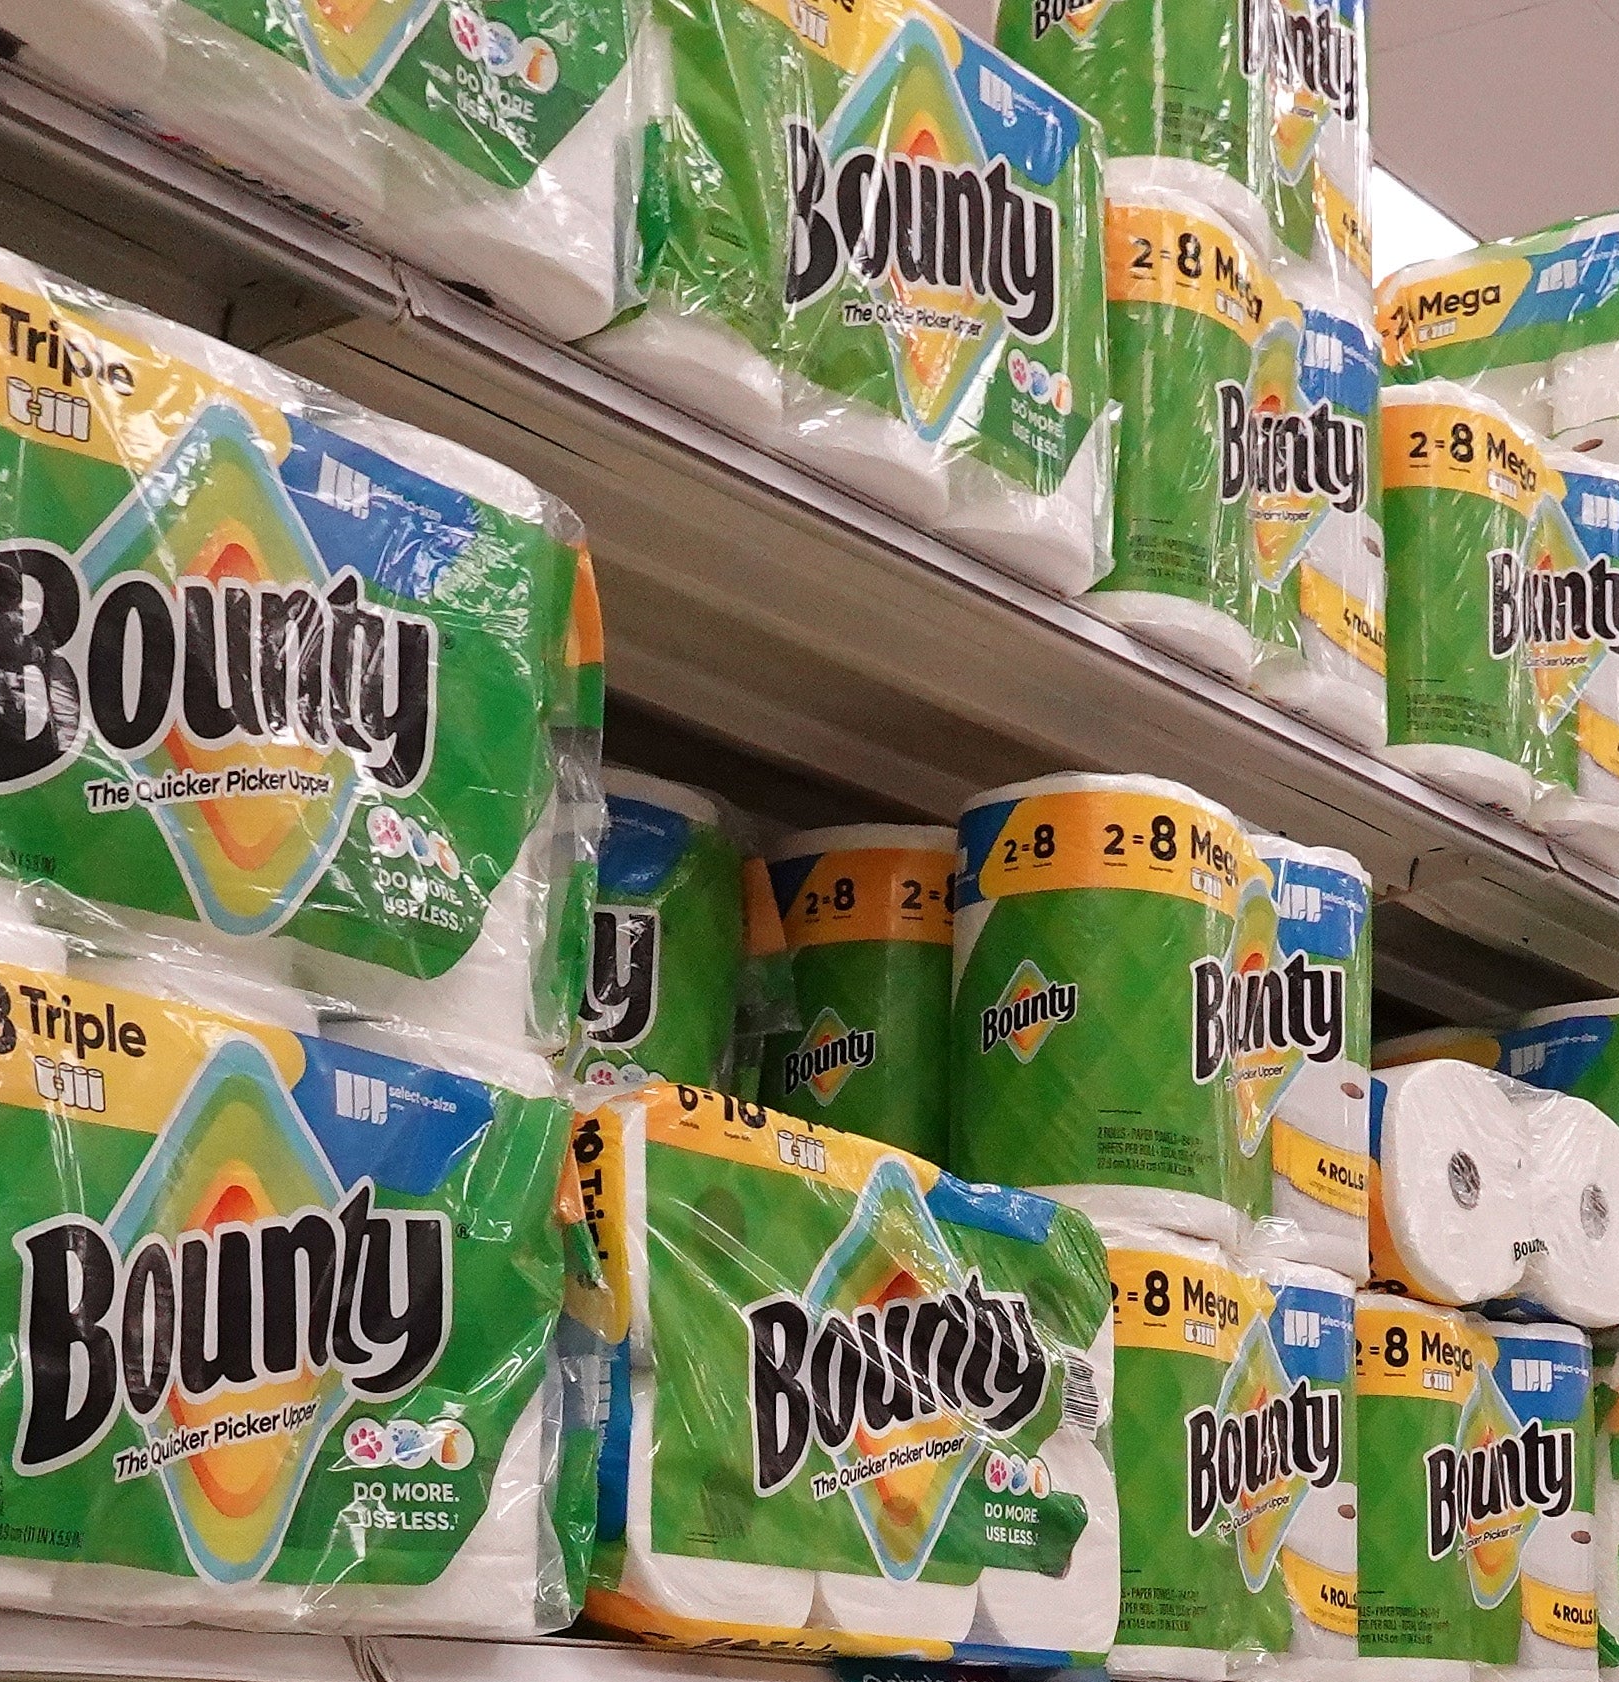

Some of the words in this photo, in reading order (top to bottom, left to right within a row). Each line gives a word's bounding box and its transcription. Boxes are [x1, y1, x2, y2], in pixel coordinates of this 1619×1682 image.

[787, 123, 1057, 336] Bounty
[1417, 284, 1501, 321] Mega
[0, 303, 134, 396] Triple
[87, 784, 130, 808] The
[136, 771, 223, 804] Quicker
[227, 767, 285, 794] Picker
[20, 984, 148, 1061] Triple
[981, 982, 1078, 1054] Bounty
[1191, 955, 1343, 1083] Bounty
[784, 1029, 876, 1095] Bounty
[21, 1186, 444, 1466] Bounty
[1183, 1276, 1239, 1326] Mega
[753, 1276, 1049, 1490] Bounty
[1420, 1330, 1473, 1372] Mega
[116, 1453, 148, 1480] The
[150, 1428, 209, 1463] Quicker
[214, 1412, 281, 1445] Picker
[282, 1402, 319, 1431] Upper
[813, 1474, 838, 1500] The
[840, 1458, 887, 1487] Quicker
[889, 1445, 924, 1472] Picker
[925, 1437, 965, 1464] Upper
[1189, 1377, 1342, 1536] Bounty
[353, 1482, 387, 1502] DO
[392, 1482, 460, 1504] MORE.
[984, 1503, 1003, 1520] DO
[1427, 1420, 1577, 1559] Bounty
[985, 1526, 1007, 1543] USE
[1562, 1603, 1593, 1626] ROLLS
